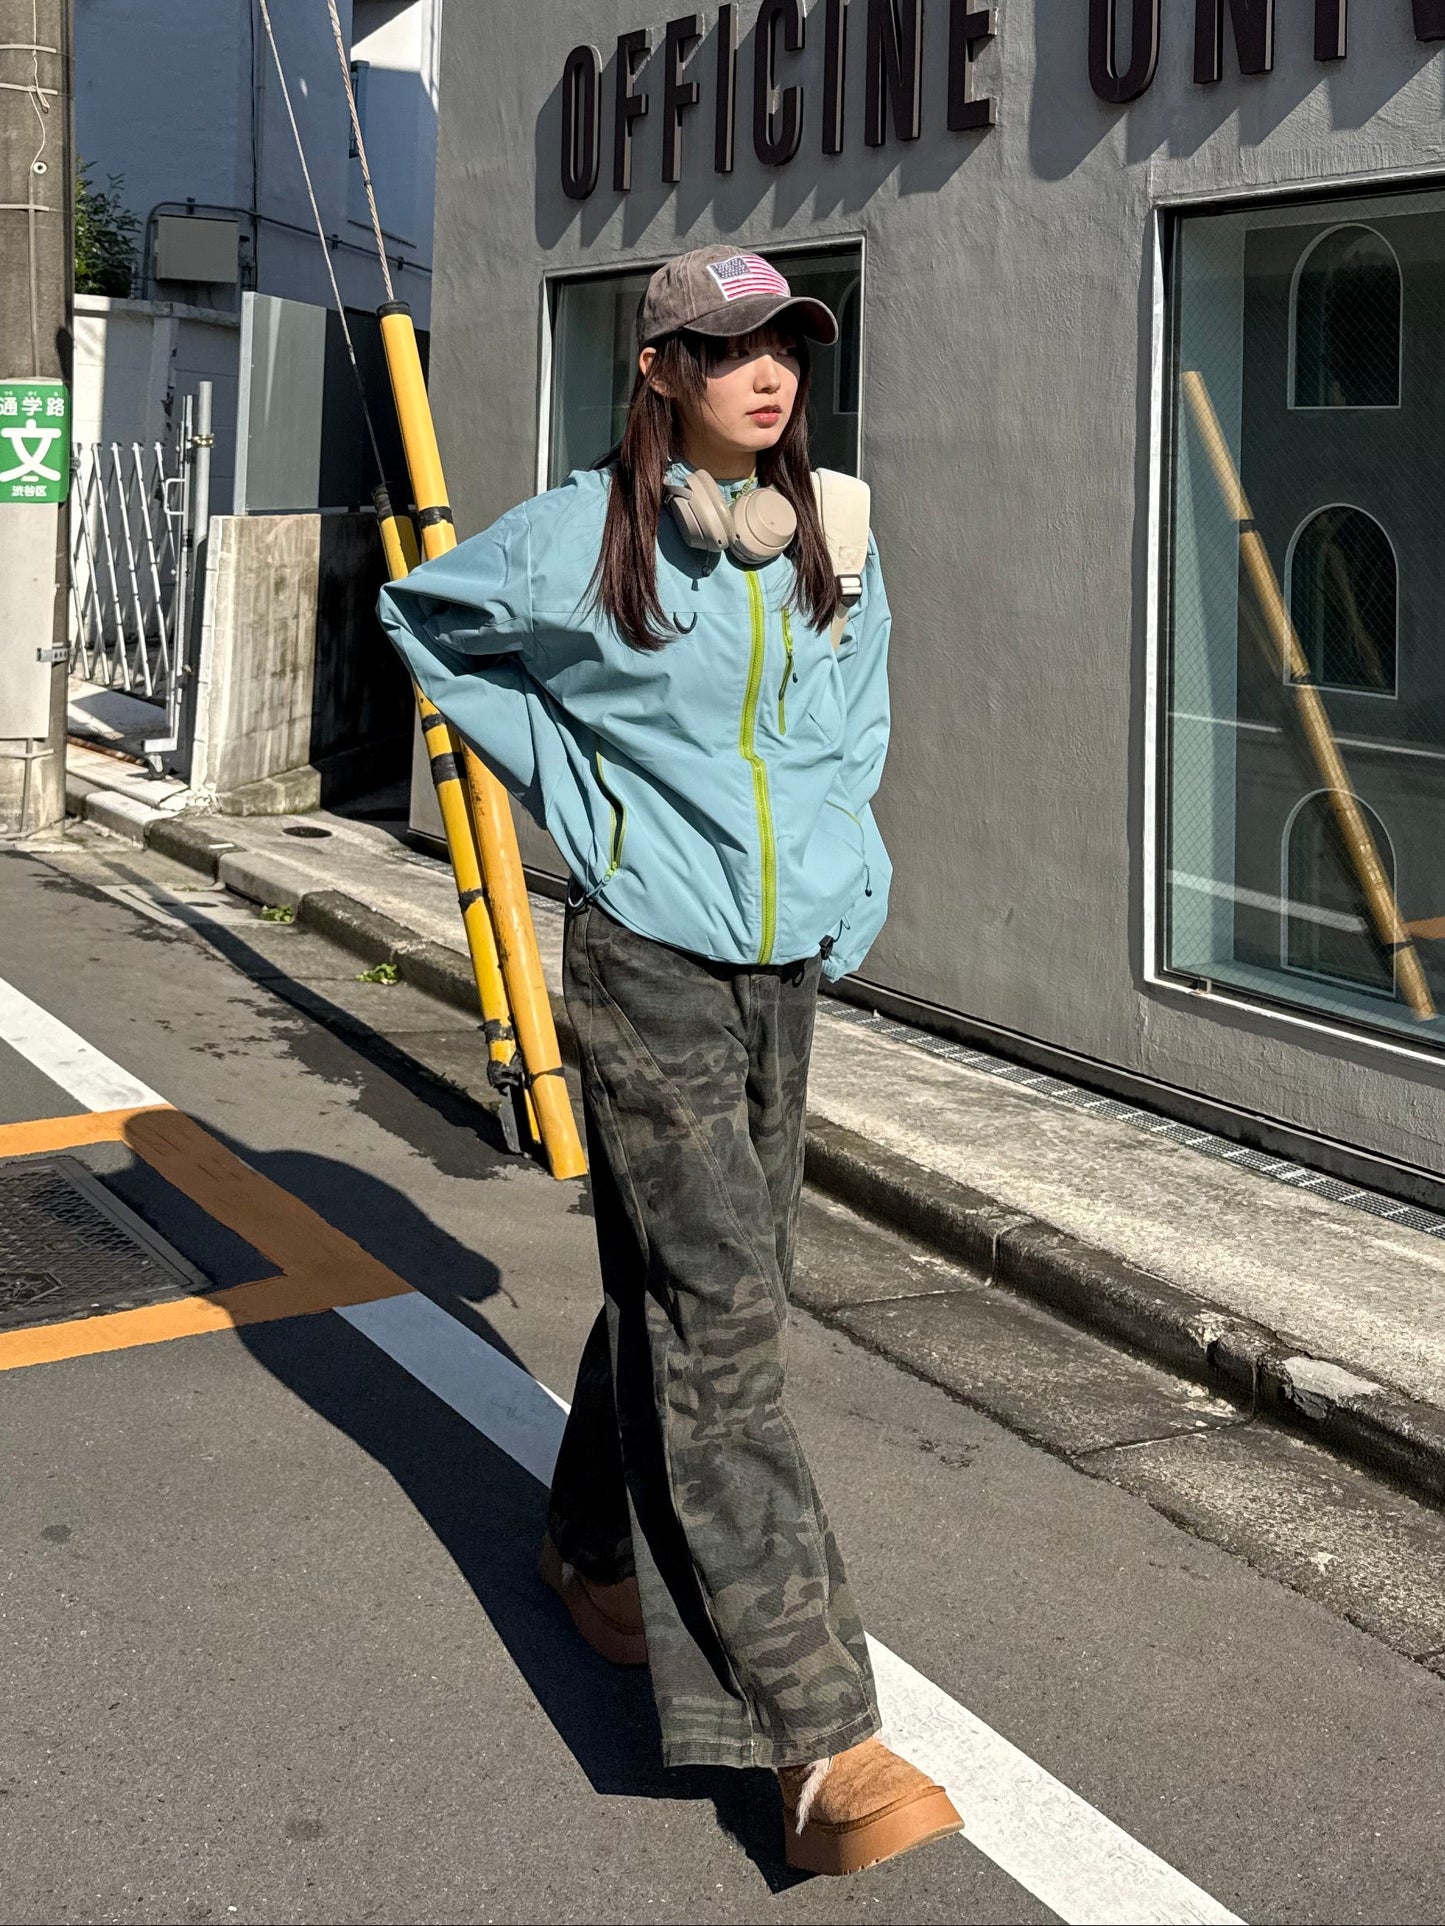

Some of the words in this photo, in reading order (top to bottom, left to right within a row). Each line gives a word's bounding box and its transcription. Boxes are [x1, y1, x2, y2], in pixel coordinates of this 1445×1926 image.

[561, 0, 996, 199] OFFICINE
[0, 396, 64, 416] 通学路
[0, 419, 61, 482] 文
[11, 485, 47, 497] 渋谷区
